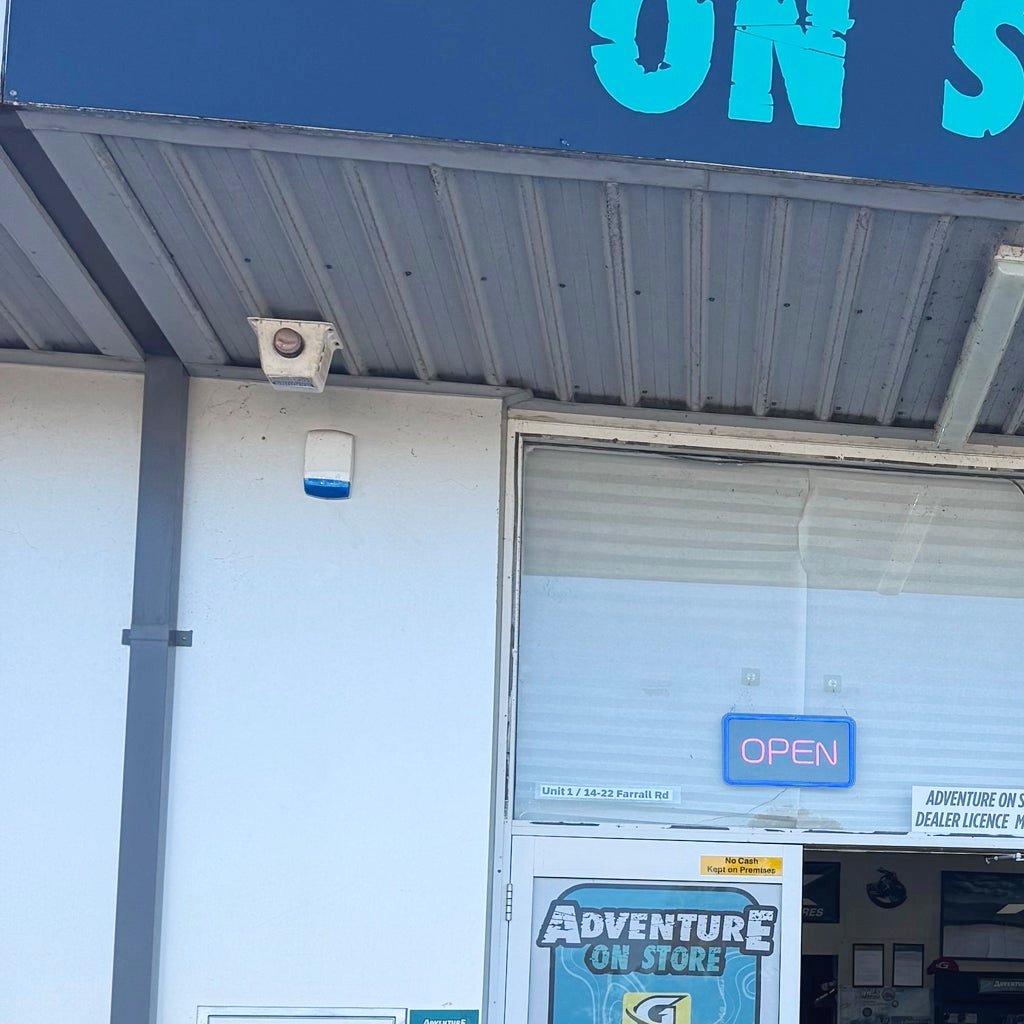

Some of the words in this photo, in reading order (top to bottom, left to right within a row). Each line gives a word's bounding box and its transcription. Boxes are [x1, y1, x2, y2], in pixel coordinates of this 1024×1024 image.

[590, 0, 856, 129] ON
[740, 737, 838, 767] OPEN
[542, 786, 565, 796] Unit
[567, 787, 574, 796] 1
[584, 788, 614, 798] 14-22
[616, 789, 652, 799] Farrall
[655, 791, 669, 800] Rd
[925, 788, 995, 809] ADVENTURE
[997, 791, 1016, 809] ON
[915, 810, 960, 830] DEALER
[963, 811, 1010, 830] LICENCE
[707, 865, 726, 874] Kept
[740, 866, 776, 874] Premises
[724, 857, 737, 865] No
[738, 857, 759, 865] Cash
[541, 904, 776, 952] ADVENTURE
[591, 943, 630, 971] ON
[641, 945, 721, 973] STORE
